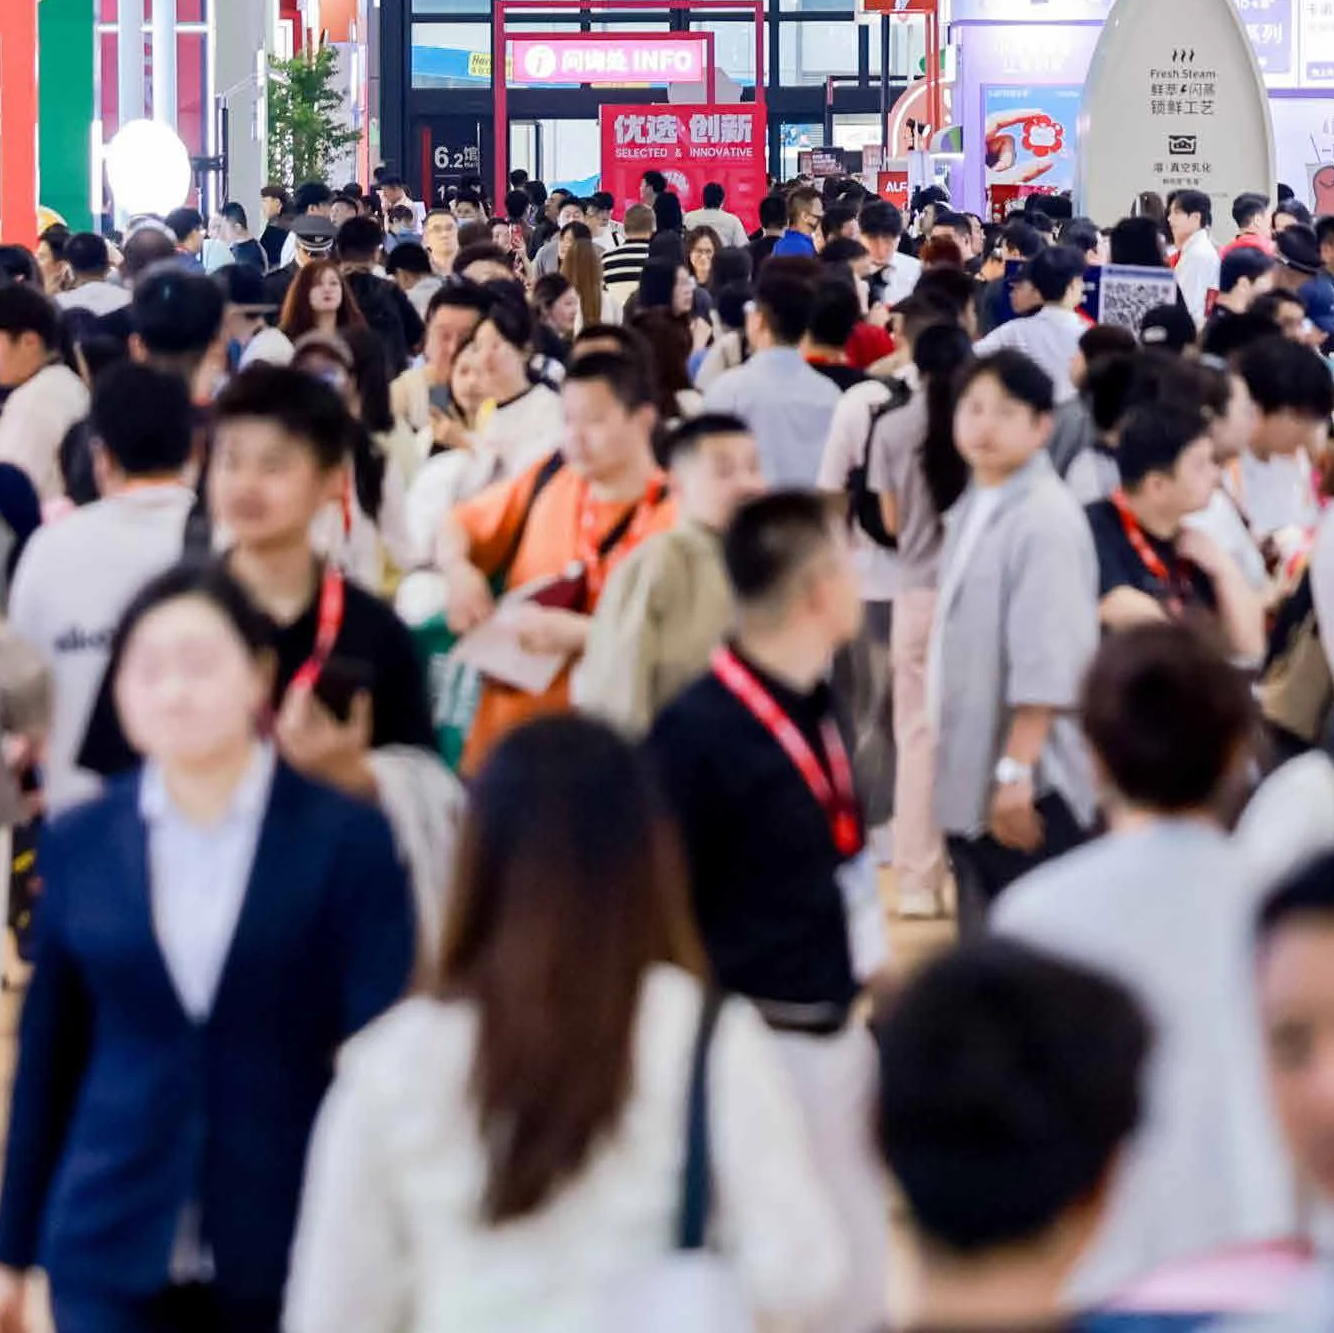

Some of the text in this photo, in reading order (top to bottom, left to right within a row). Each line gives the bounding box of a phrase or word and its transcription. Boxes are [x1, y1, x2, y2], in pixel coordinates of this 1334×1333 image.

[633, 49, 693, 73] INFO
[1150, 68, 1216, 79] Fresh Steam
[434, 146, 464, 169] 6.2
[616, 147, 754, 158] SELECTED & INNOVATIVE
